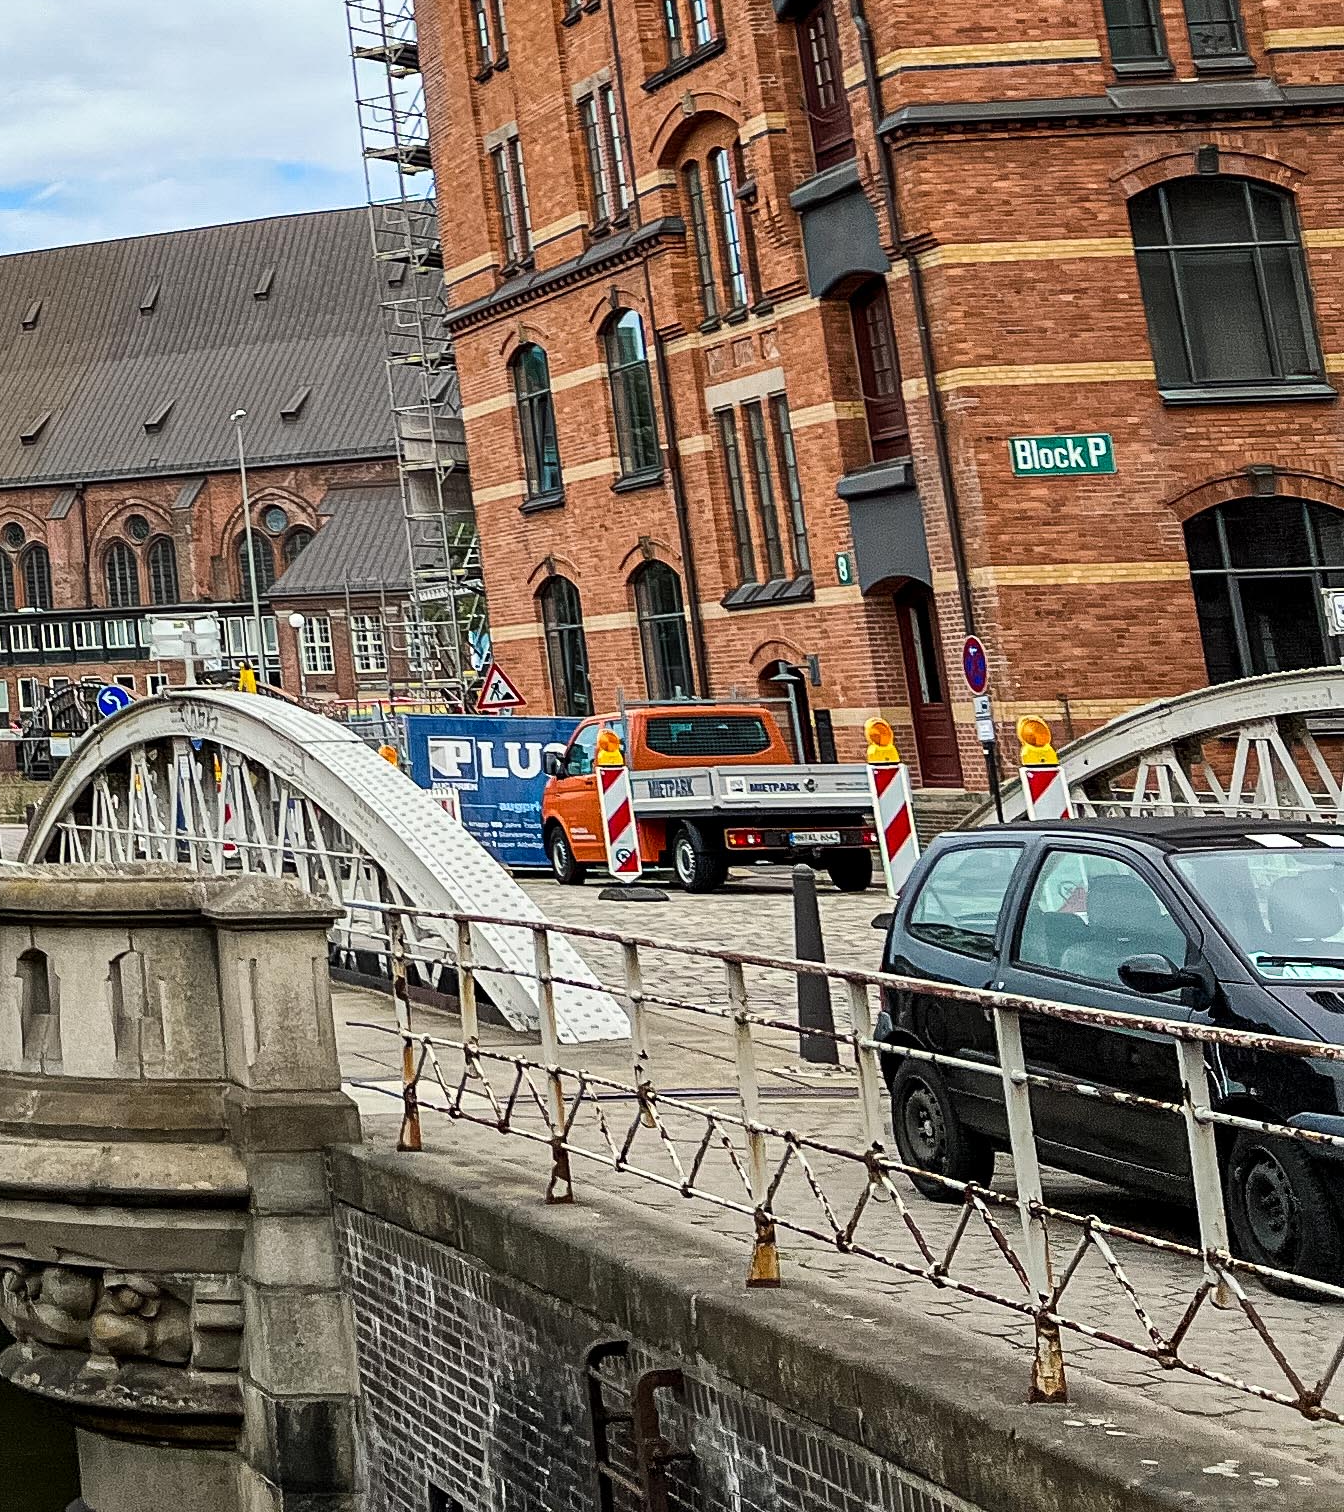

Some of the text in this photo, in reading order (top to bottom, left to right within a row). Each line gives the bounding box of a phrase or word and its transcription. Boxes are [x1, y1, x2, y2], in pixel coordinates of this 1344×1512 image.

[1014, 437, 1107, 470] Block P
[837, 556, 849, 582] 8
